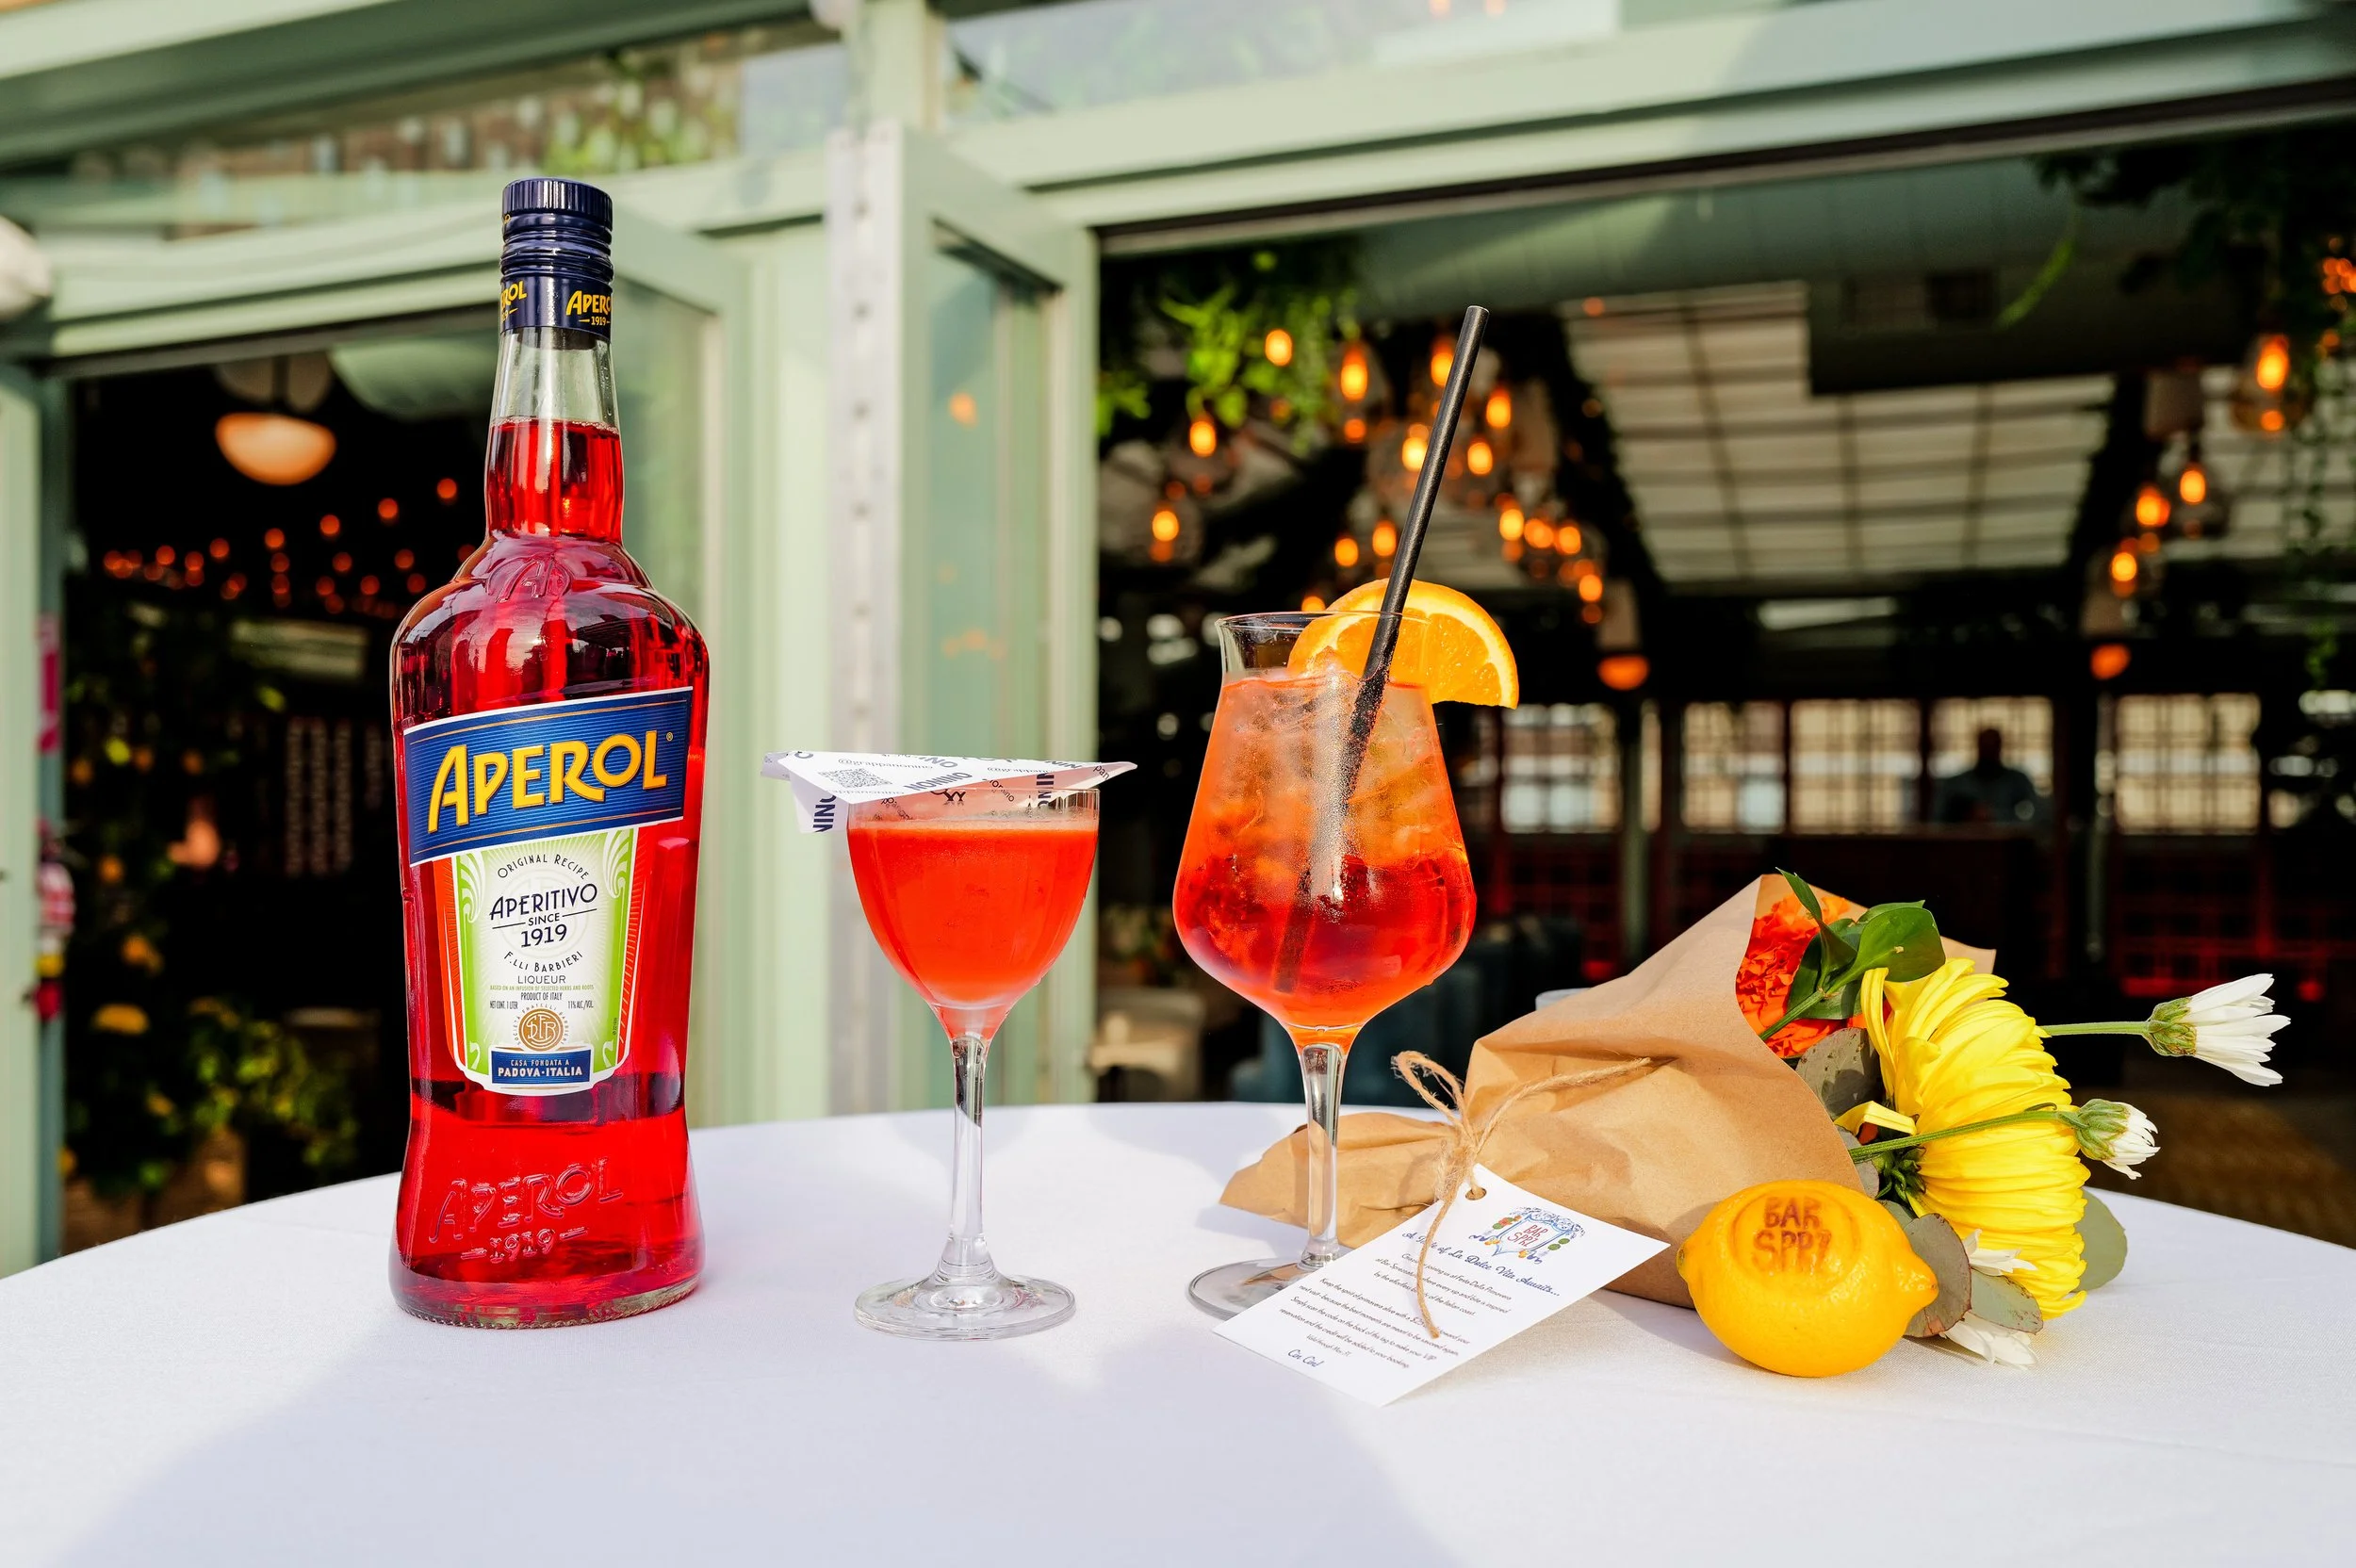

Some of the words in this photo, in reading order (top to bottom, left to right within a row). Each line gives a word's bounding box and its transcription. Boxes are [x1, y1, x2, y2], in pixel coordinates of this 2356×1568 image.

[591, 316, 606, 325] 1919
[427, 730, 667, 834] APEROL
[498, 854, 548, 878] ORIGINAL
[554, 854, 589, 879] RECIPE
[489, 883, 597, 921] APERITIVO
[528, 912, 560, 926] SINCE
[521, 923, 567, 948] 1919
[504, 951, 529, 970] F.LLI
[534, 951, 582, 972] BARBIERI
[517, 975, 566, 985] LIQUEUR
[521, 992, 541, 1001] PRODUCT
[429, 1157, 623, 1243] APEROL
[1523, 1224, 1548, 1237] BAR
[1448, 1250, 1464, 1259] La
[1464, 1254, 1492, 1270] Dolce
[1495, 1266, 1515, 1279] Vita
[1287, 1348, 1302, 1360] Cin
